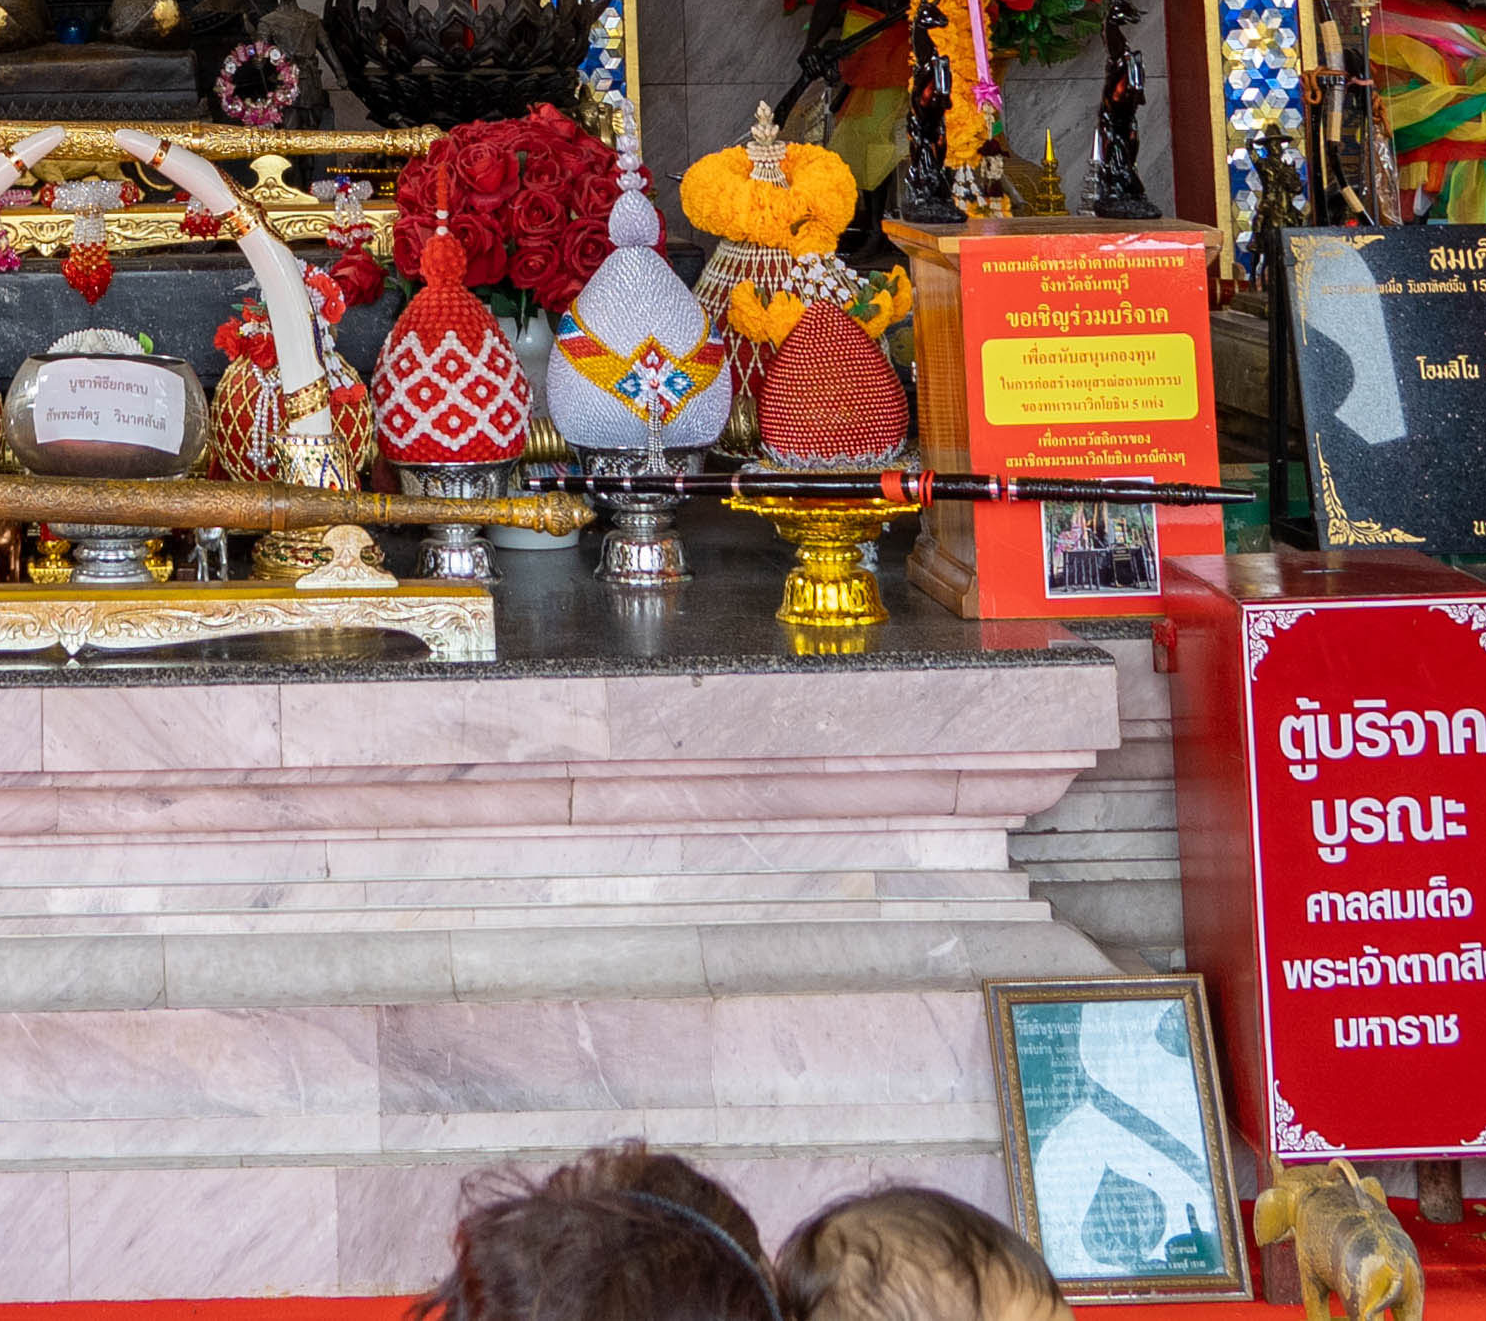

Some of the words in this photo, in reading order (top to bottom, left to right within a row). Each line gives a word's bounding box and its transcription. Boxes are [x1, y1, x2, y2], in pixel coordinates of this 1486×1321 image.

[1005, 301, 1170, 333] ขอเชิญร่วมบริจาค
[1417, 354, 1480, 380] โอมสิโน
[1311, 796, 1467, 863] บูรณะ
[1306, 875, 1472, 923] ศาลสมเด็จ
[1334, 1013, 1459, 1049] มหาราช
